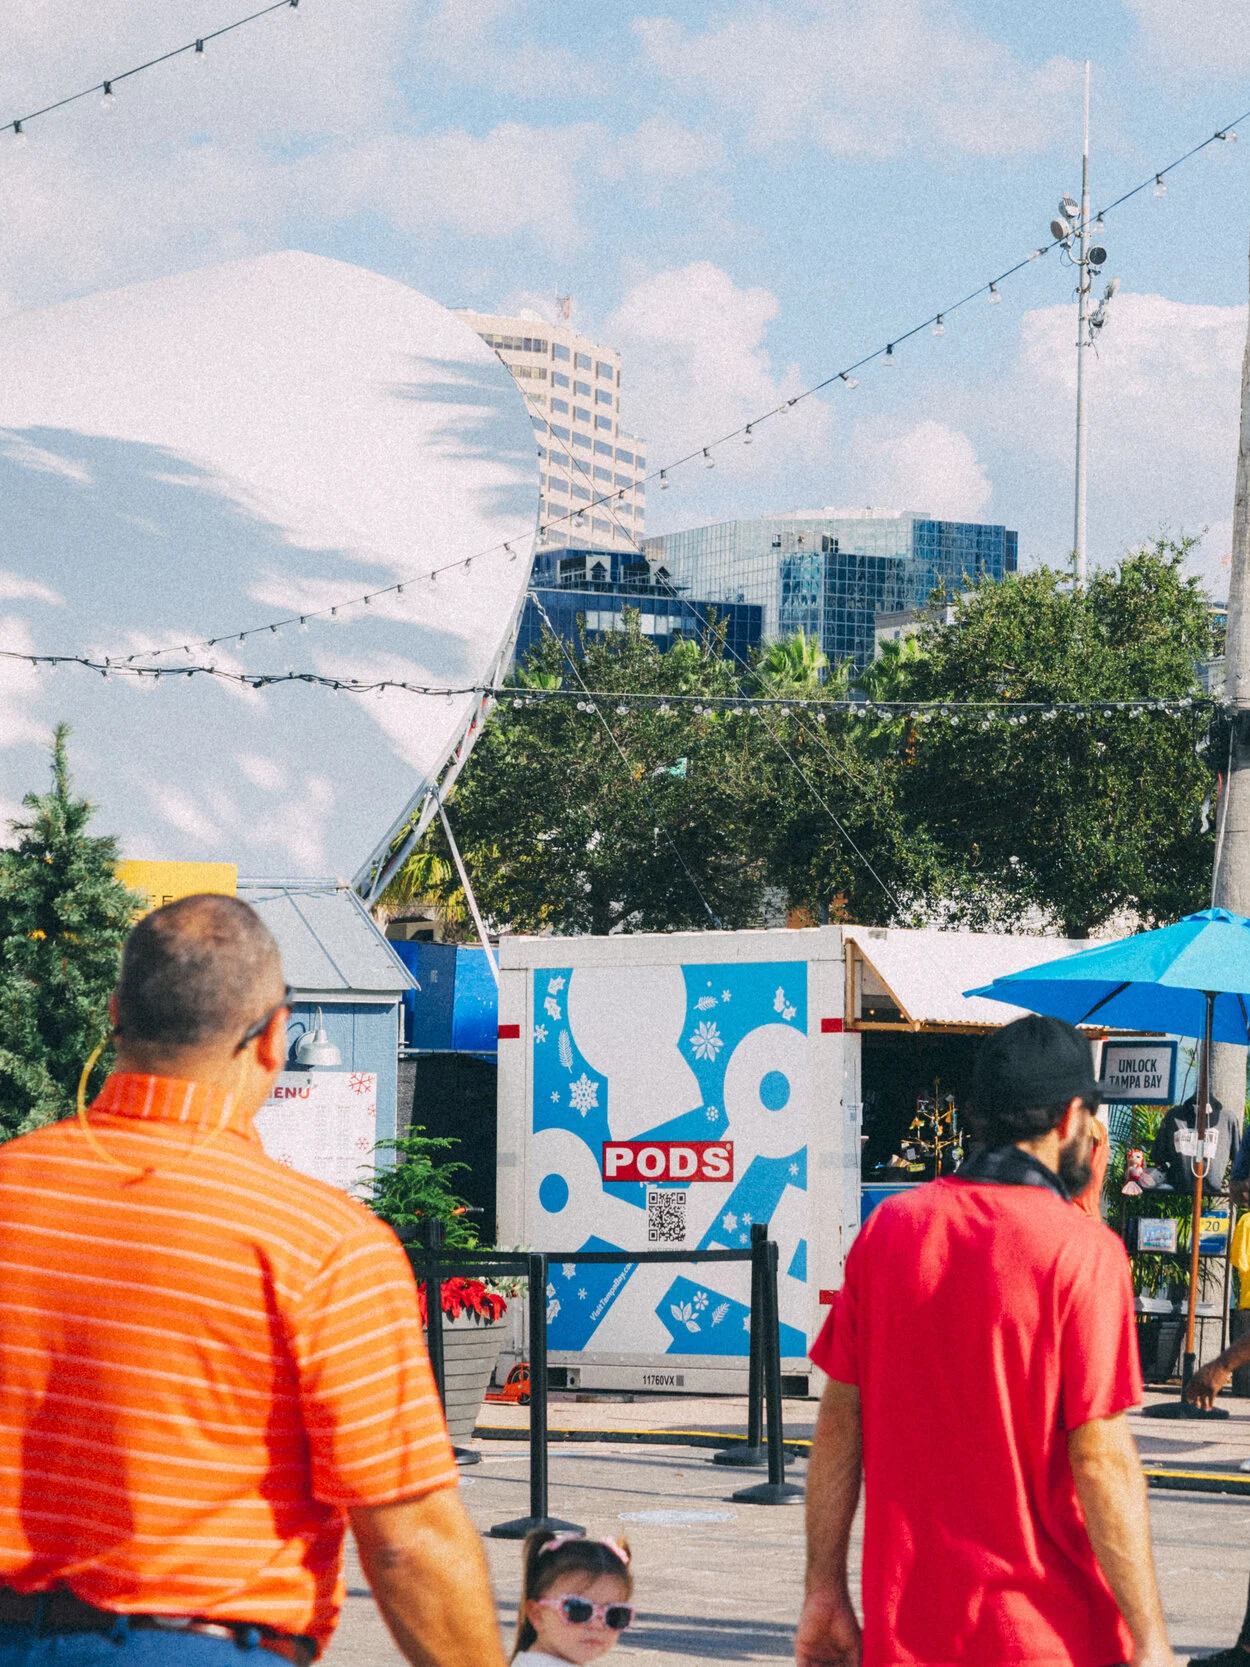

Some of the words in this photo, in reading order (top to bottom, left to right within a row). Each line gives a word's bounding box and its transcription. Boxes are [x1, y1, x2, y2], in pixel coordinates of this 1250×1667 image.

[1118, 1058, 1157, 1073] UNLOCK
[1109, 1074, 1141, 1089] TAMPA
[1143, 1074, 1163, 1089] BAY
[268, 1086, 311, 1099] ENU
[605, 1147, 731, 1178] PODS
[589, 1262, 633, 1321] VisitTampaBay.co
[642, 1374, 675, 1387] 11760VX
